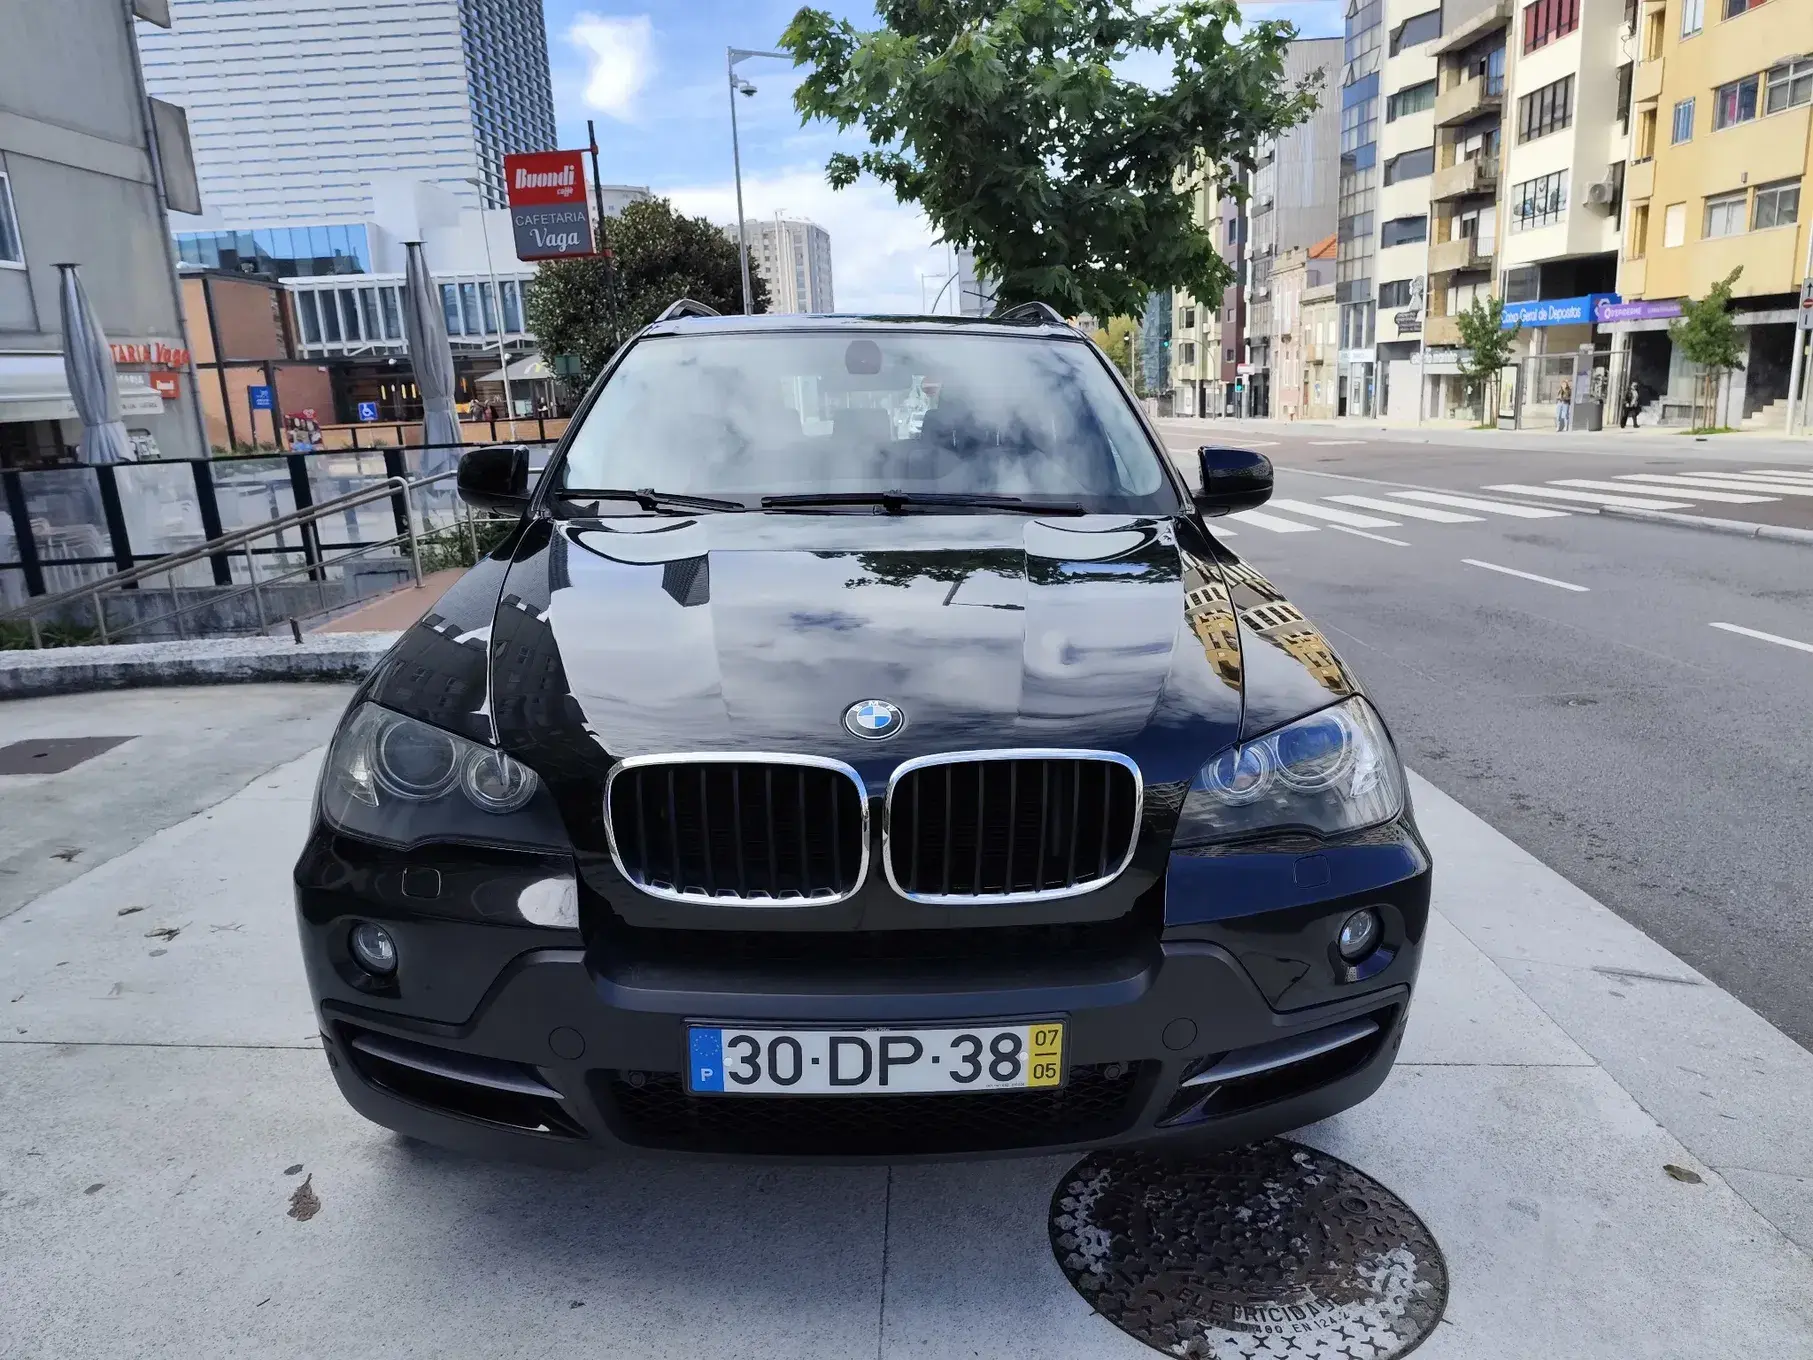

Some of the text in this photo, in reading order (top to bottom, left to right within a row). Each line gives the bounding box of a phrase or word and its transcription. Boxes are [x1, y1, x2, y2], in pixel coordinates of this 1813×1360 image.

[515, 165, 575, 189] Buondi
[515, 211, 586, 226] CAFETARIA
[529, 228, 580, 252] Vaga
[109, 344, 151, 363] TARIA
[1035, 1029, 1059, 1046] 07
[700, 1068, 714, 1082] P
[1033, 1063, 1057, 1079] 05
[1292, 1322, 1312, 1333] EN
